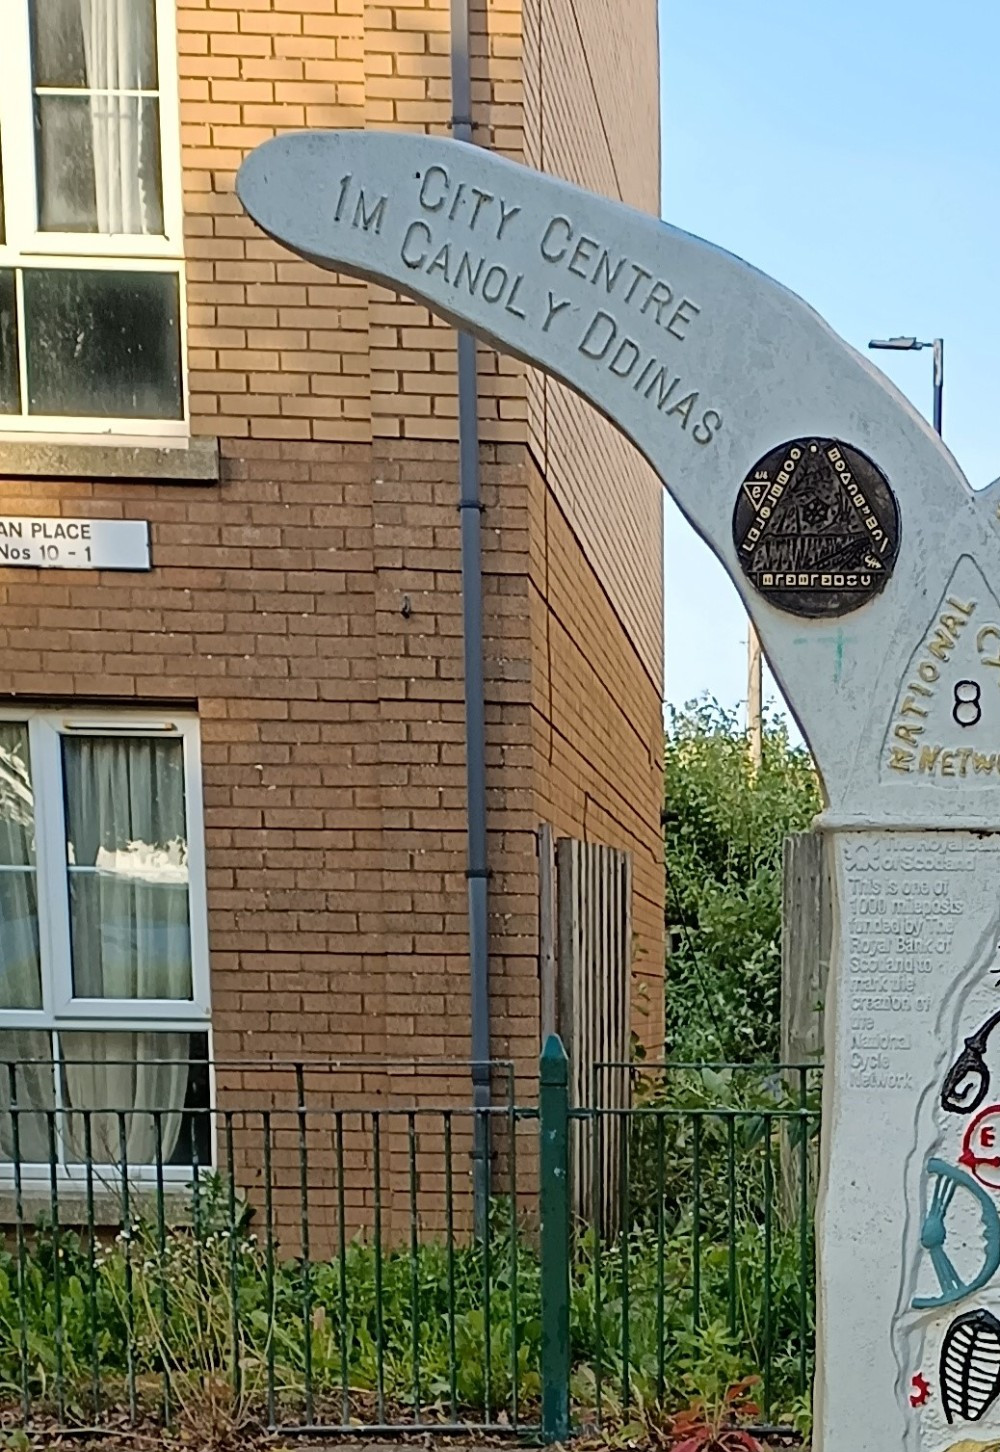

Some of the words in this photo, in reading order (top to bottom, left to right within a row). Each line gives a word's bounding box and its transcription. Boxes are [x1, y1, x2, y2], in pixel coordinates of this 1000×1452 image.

[419, 166, 521, 240] CITY
[541, 215, 701, 341] CENTRE
[401, 220, 525, 319] CANOL
[543, 291, 570, 332] Y
[578, 310, 723, 445] DDINAS
[31, 522, 91, 539] PLACE
[40, 545, 59, 561] 10
[85, 546, 91, 562] 1
[888, 598, 977, 772] NATIONAL
[953, 680, 981, 728] 8
[891, 898, 964, 918] mileposts
[850, 1052, 890, 1073] Cycle
[849, 1071, 913, 1089] Network
[980, 1126, 996, 1147] E
